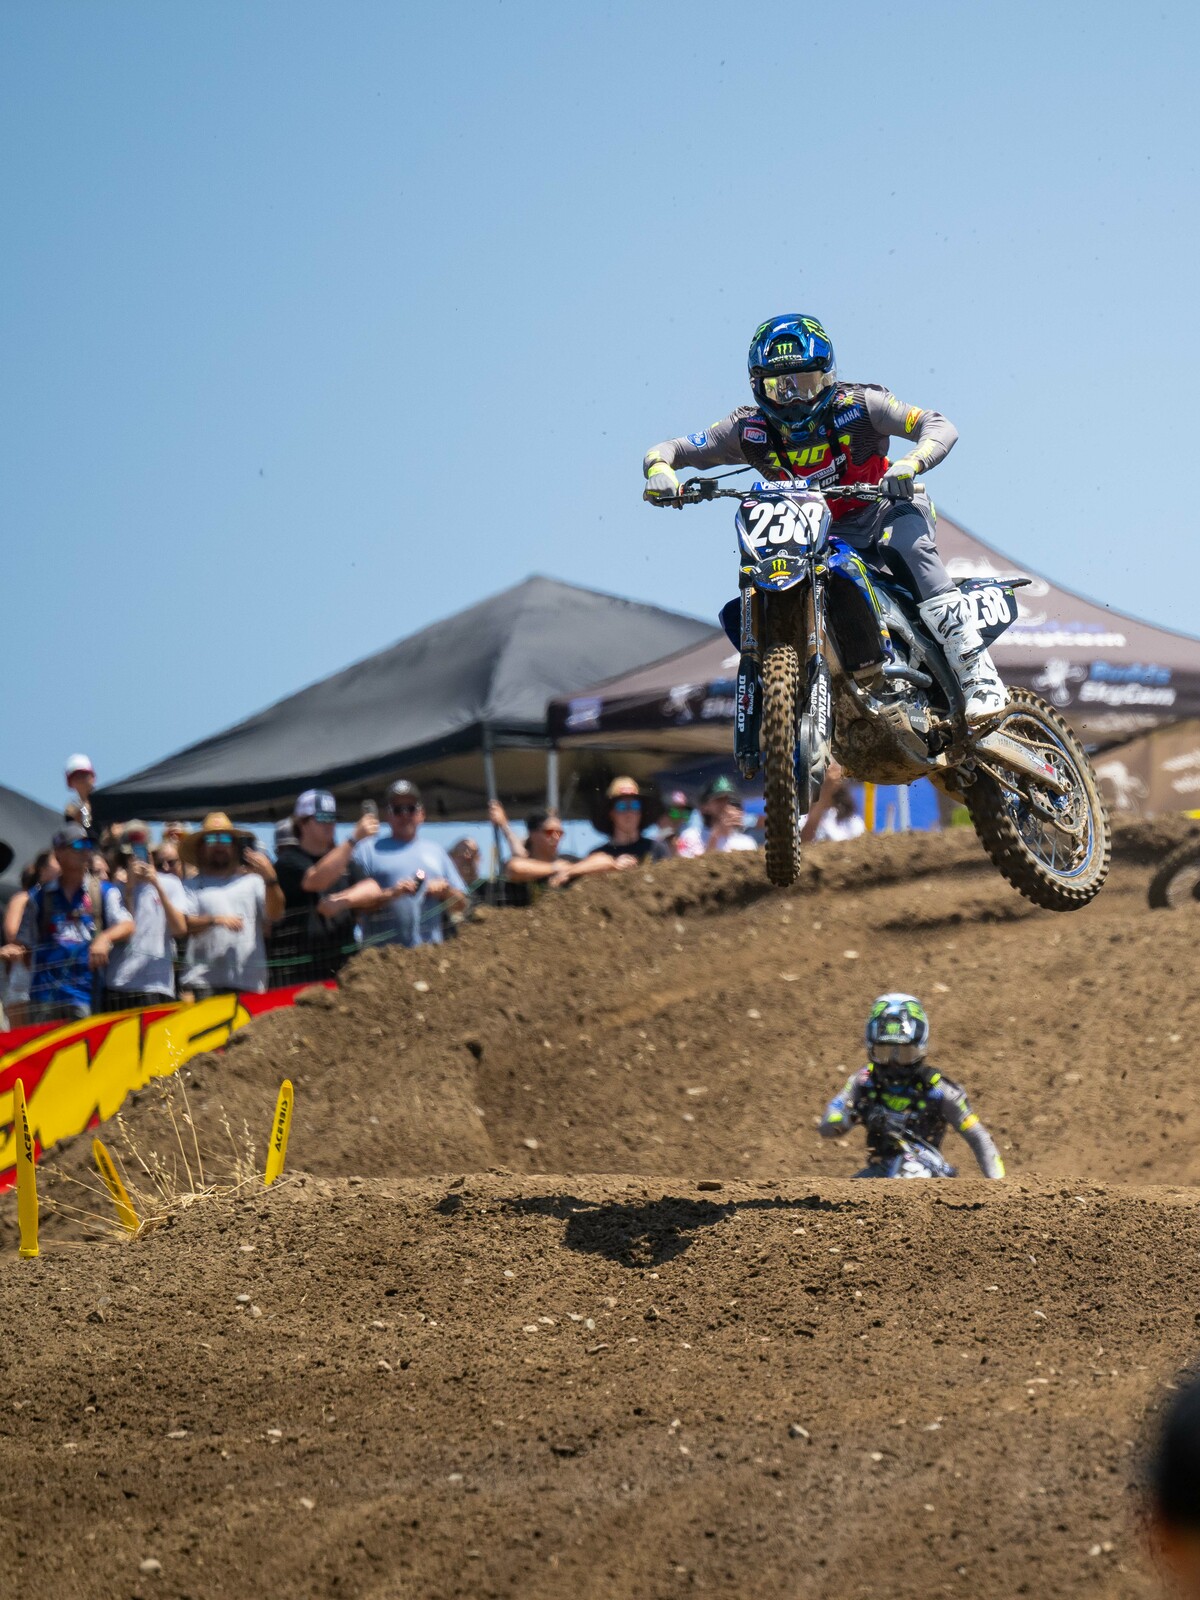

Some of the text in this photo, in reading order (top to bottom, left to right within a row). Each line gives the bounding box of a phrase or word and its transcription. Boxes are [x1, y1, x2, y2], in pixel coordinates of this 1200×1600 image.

[747, 430, 763, 441] 100%
[835, 453, 847, 466] 238
[748, 500, 823, 548] 238
[961, 586, 1012, 629] 238
[737, 674, 747, 733] DUNLOP
[818, 674, 829, 736] DUNLOP
[274, 1100, 289, 1153] ACERBIS
